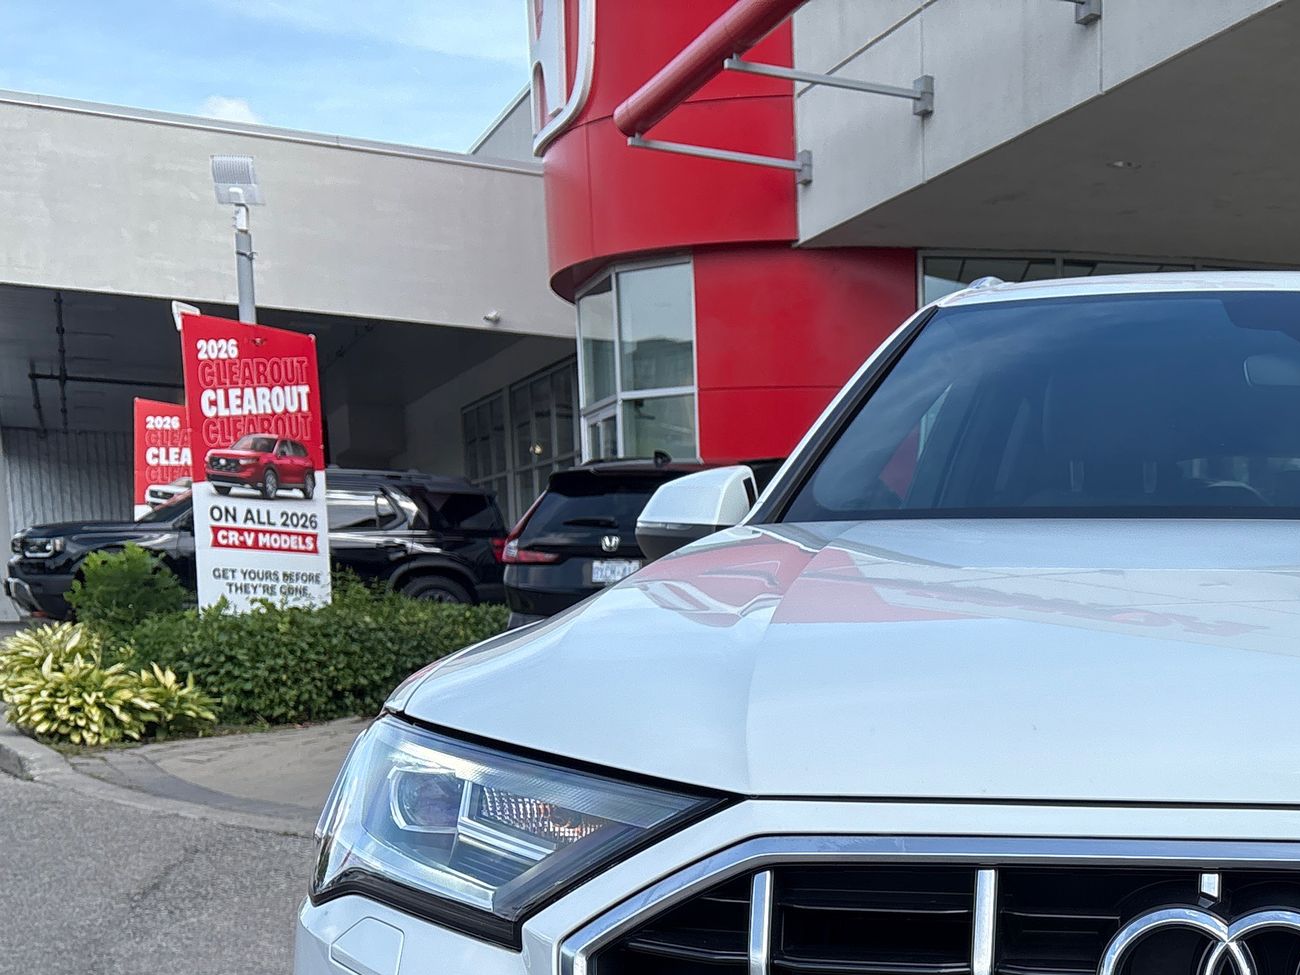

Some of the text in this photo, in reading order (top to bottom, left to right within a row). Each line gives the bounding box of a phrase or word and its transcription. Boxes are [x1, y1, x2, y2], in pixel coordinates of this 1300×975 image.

[196, 338, 238, 359] 2026
[198, 357, 308, 388] CLEAROUT
[201, 385, 310, 418] CLEAROUT
[145, 415, 180, 430] 2026
[202, 412, 312, 447] CLEAROUT
[145, 429, 192, 447] CLEA
[145, 446, 193, 466] CLEA
[145, 464, 193, 484] CLEA
[209, 505, 318, 530] ON ALL 2026
[216, 529, 314, 551] CR-V MODELS
[212, 568, 320, 584] GET YOURS BEFORE
[226, 582, 277, 596] THEY'RE
